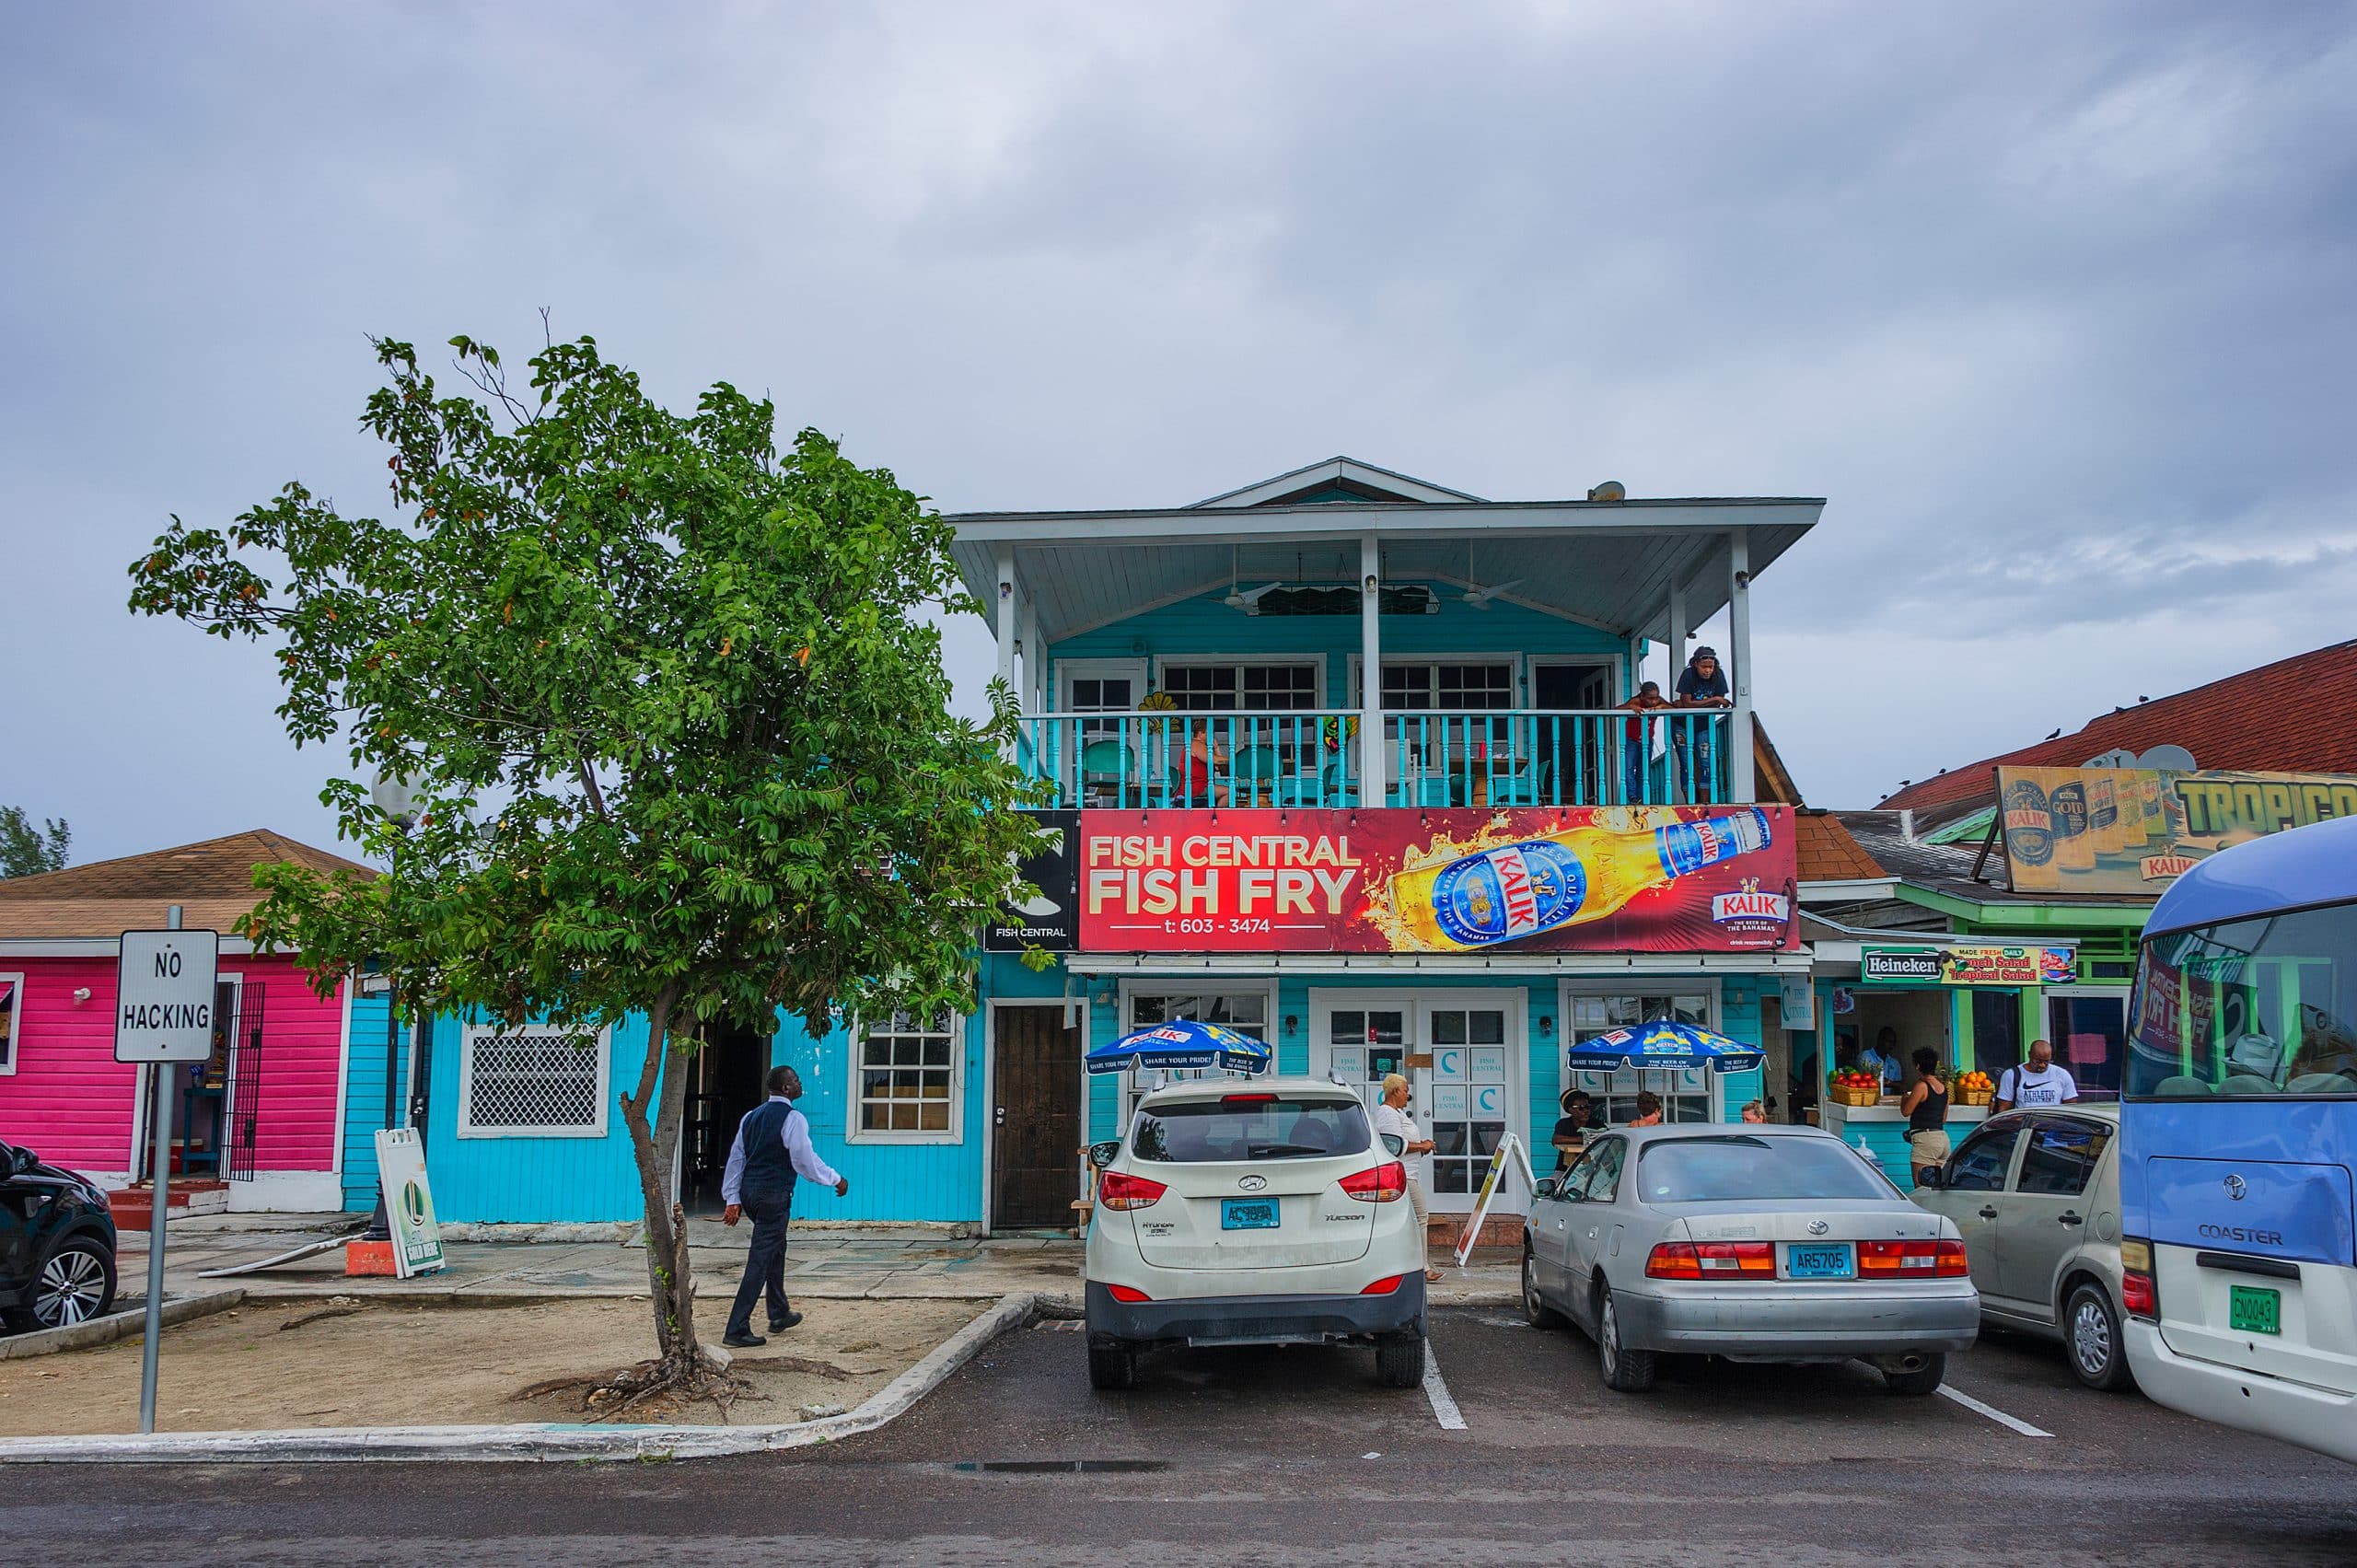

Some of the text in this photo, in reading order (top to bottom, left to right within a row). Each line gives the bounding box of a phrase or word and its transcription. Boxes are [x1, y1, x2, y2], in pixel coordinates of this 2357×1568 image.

[2008, 811, 2048, 828] KALIK
[1089, 836, 1361, 866] FISH CENTRAL
[1696, 825, 1718, 860] KALIK
[1088, 868, 1357, 915] FISH FRY
[1494, 854, 1535, 929] KALIK
[1545, 873, 1577, 925] QUALITY
[1723, 896, 1778, 915] KALIK
[995, 927, 1068, 937] FISH CENTRAL
[1165, 919, 1177, 934] t:
[1179, 919, 1213, 934] 603
[1229, 918, 1271, 934] 3474
[155, 951, 181, 978] NO
[1869, 957, 1937, 973] Heineken
[1996, 956, 2030, 968] Salad
[1949, 969, 2037, 981] Tropical Salad
[123, 1004, 209, 1029] HACKING
[2198, 1224, 2284, 1247] COASTER
[1797, 1252, 1844, 1269] AR5705
[2234, 1297, 2272, 1323] CN0043
